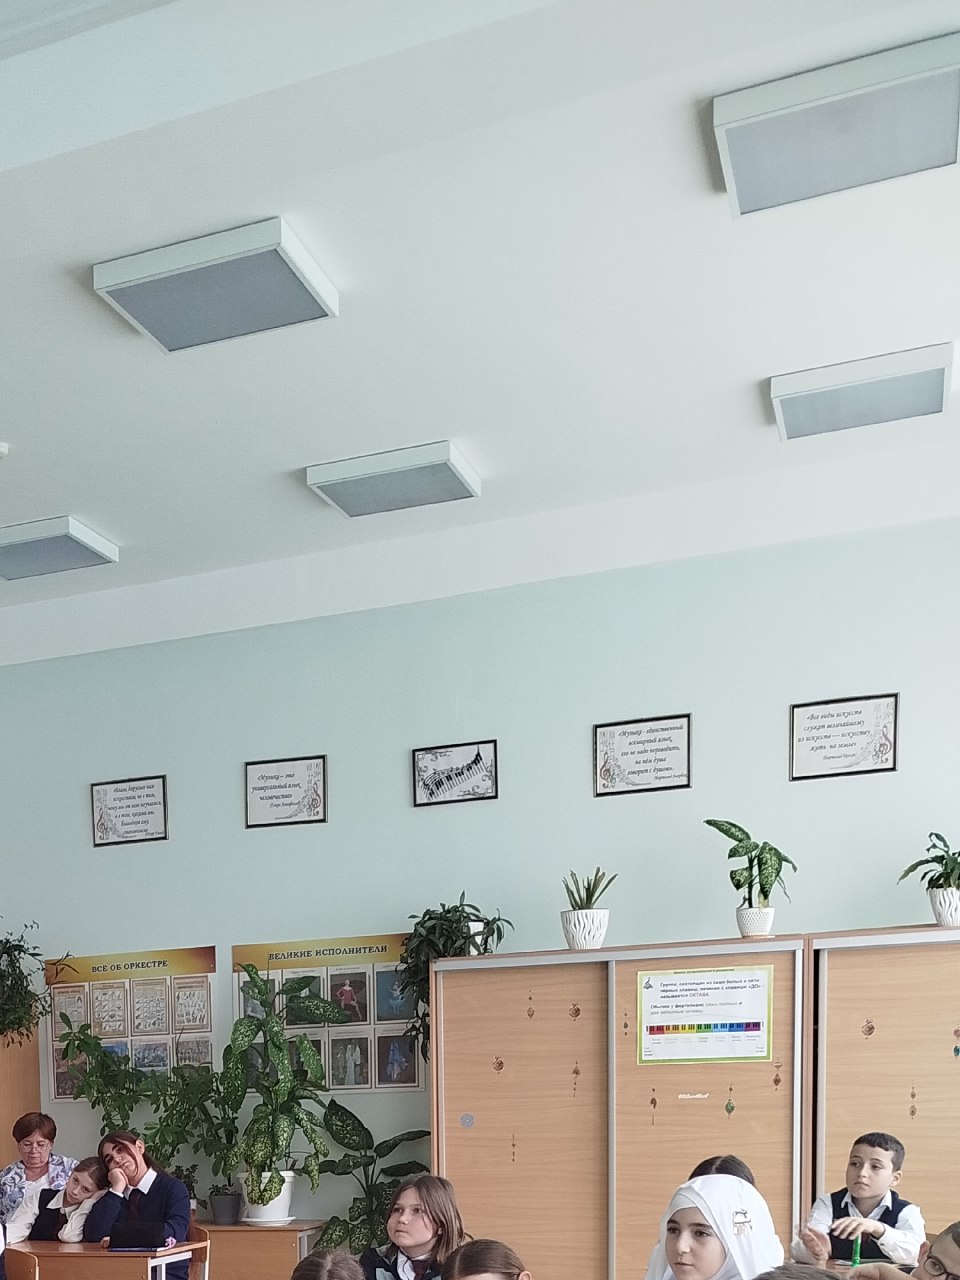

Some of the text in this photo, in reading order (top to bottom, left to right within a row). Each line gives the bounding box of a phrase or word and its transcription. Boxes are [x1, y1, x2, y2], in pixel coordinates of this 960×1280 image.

[269, 945, 388, 961] ВЕЛИКИЕ ИСПОЛНИТЕЛИ
[110, 963, 122, 971] ОБ
[124, 960, 169, 970] ОРКЕСТРЕ
